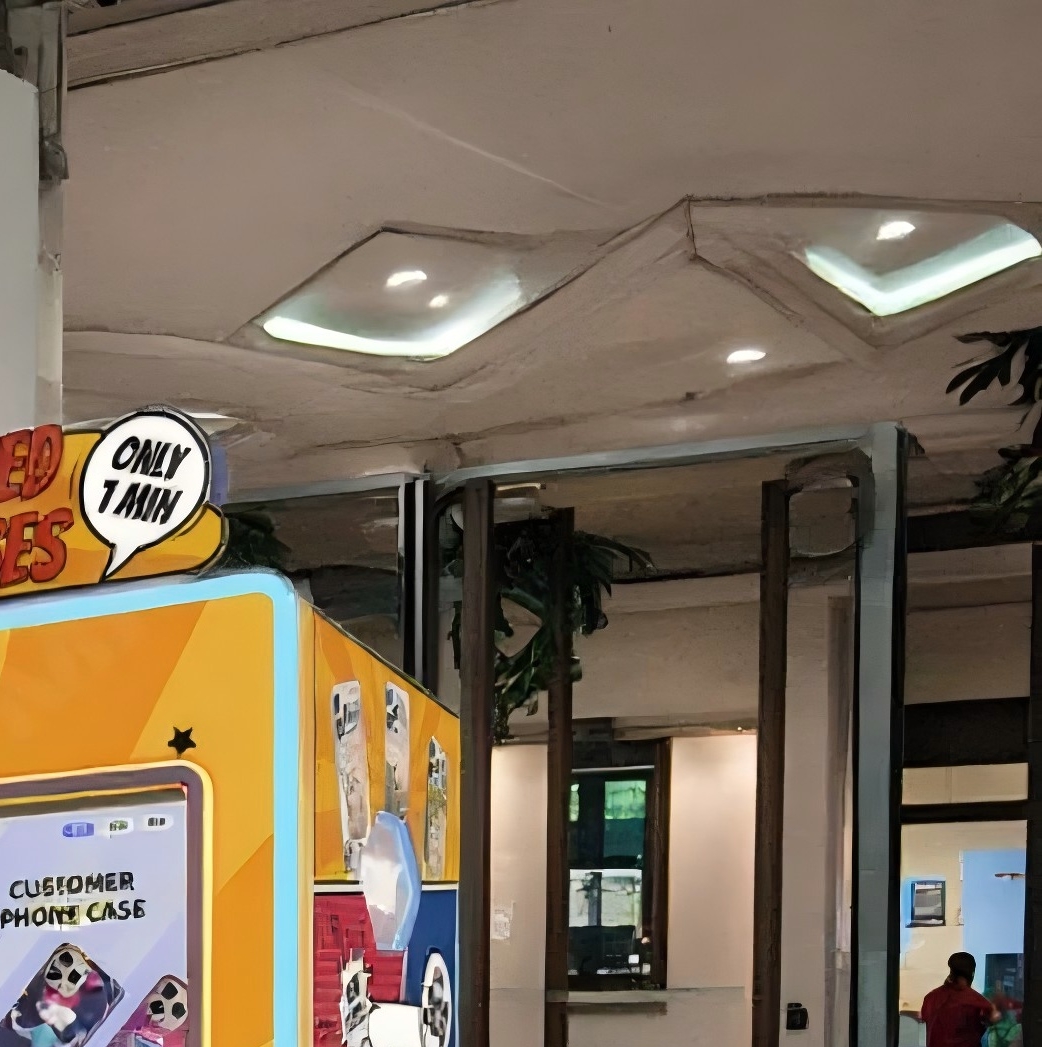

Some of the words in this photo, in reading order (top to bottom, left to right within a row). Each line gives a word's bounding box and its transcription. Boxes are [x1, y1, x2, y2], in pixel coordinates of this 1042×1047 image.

[112, 436, 192, 482] ONLY
[98, 479, 120, 514] 1
[113, 482, 184, 525] MIN
[9, 871, 135, 900] CUSTOMER
[86, 899, 146, 923] CASE
